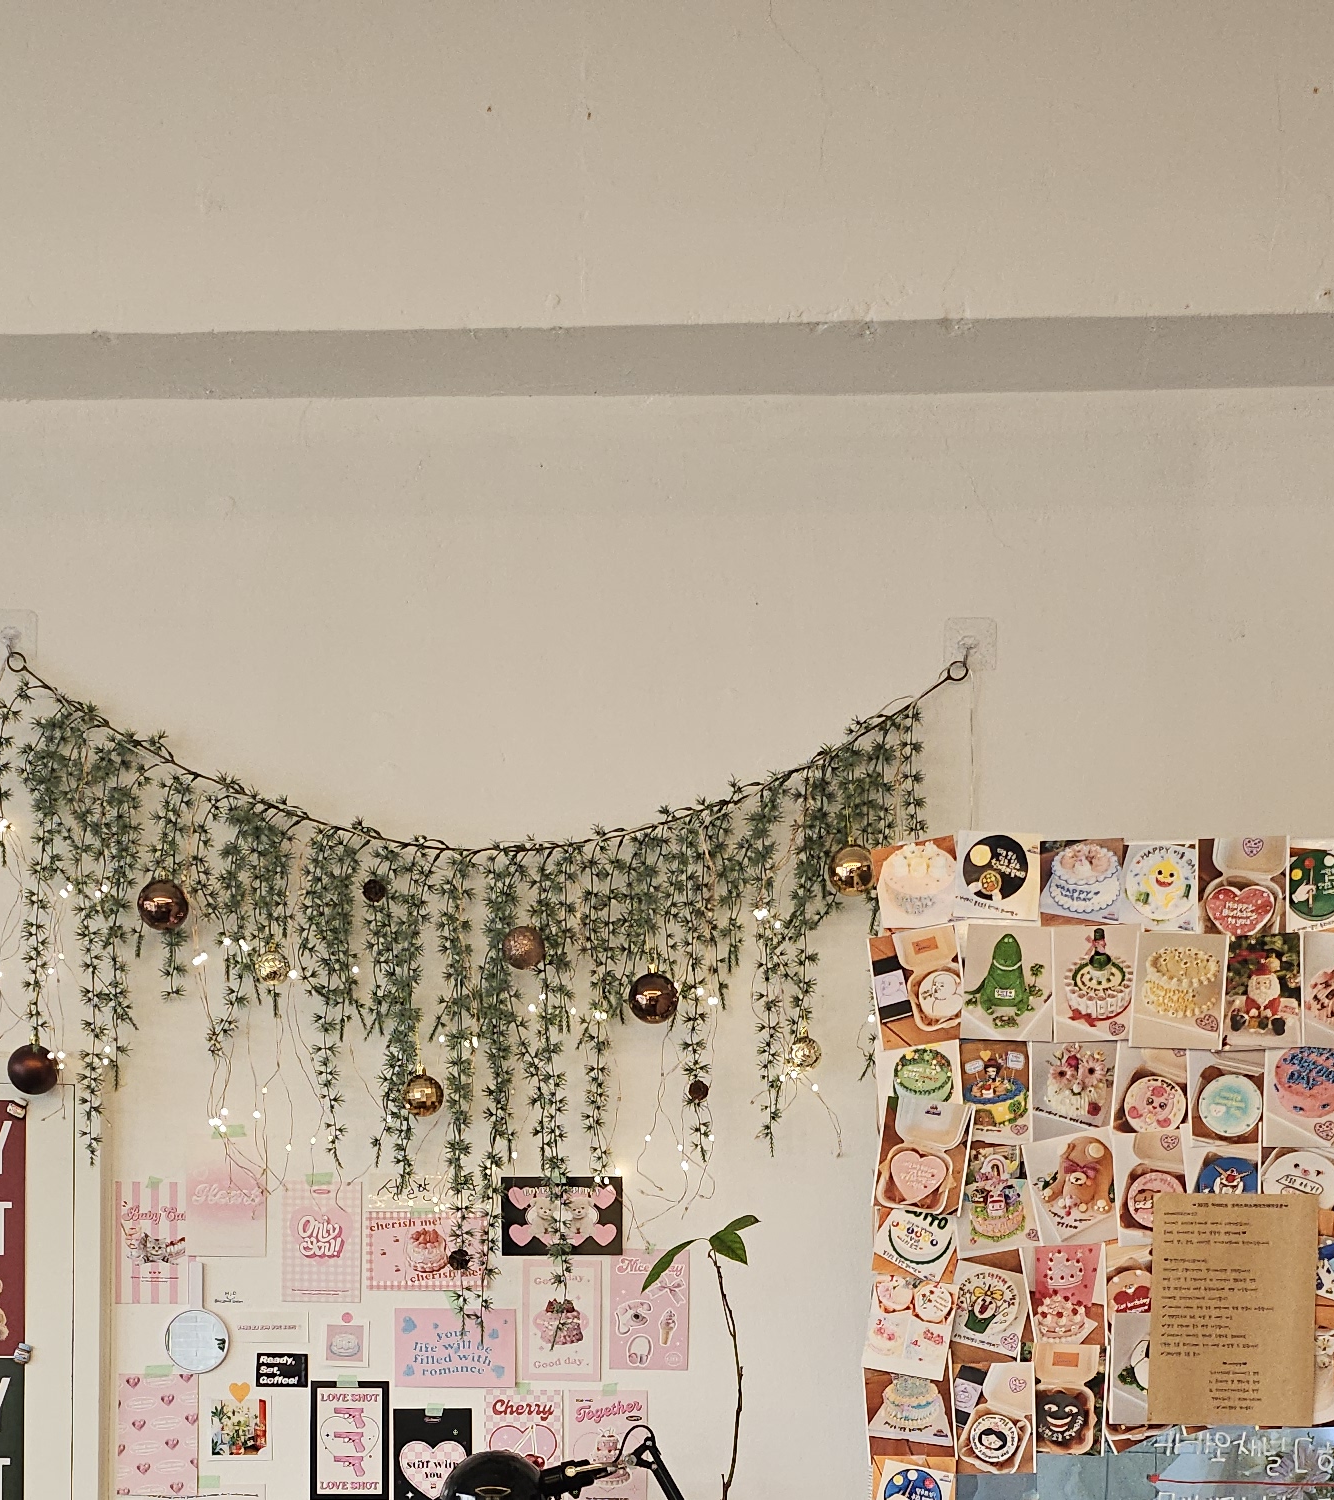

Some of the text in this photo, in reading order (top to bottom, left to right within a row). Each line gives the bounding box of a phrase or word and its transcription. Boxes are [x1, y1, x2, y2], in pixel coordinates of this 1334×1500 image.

[297, 1214, 342, 1242] Only
[369, 1216, 443, 1233] cherish me!
[298, 1236, 346, 1259] You!
[616, 1257, 651, 1274] Nice
[436, 1330, 471, 1343] your
[442, 1339, 472, 1351] will
[259, 1355, 296, 1366] Ready,
[412, 1352, 492, 1367] filled with
[533, 1356, 585, 1369] Good day
[258, 1365, 281, 1376] Set,
[422, 1364, 485, 1376] romance
[320, 1392, 380, 1403] LOVE SHOT
[492, 1398, 555, 1422] Cherry
[575, 1400, 643, 1424] Together
[319, 1481, 380, 1490] LOVE SHOT
